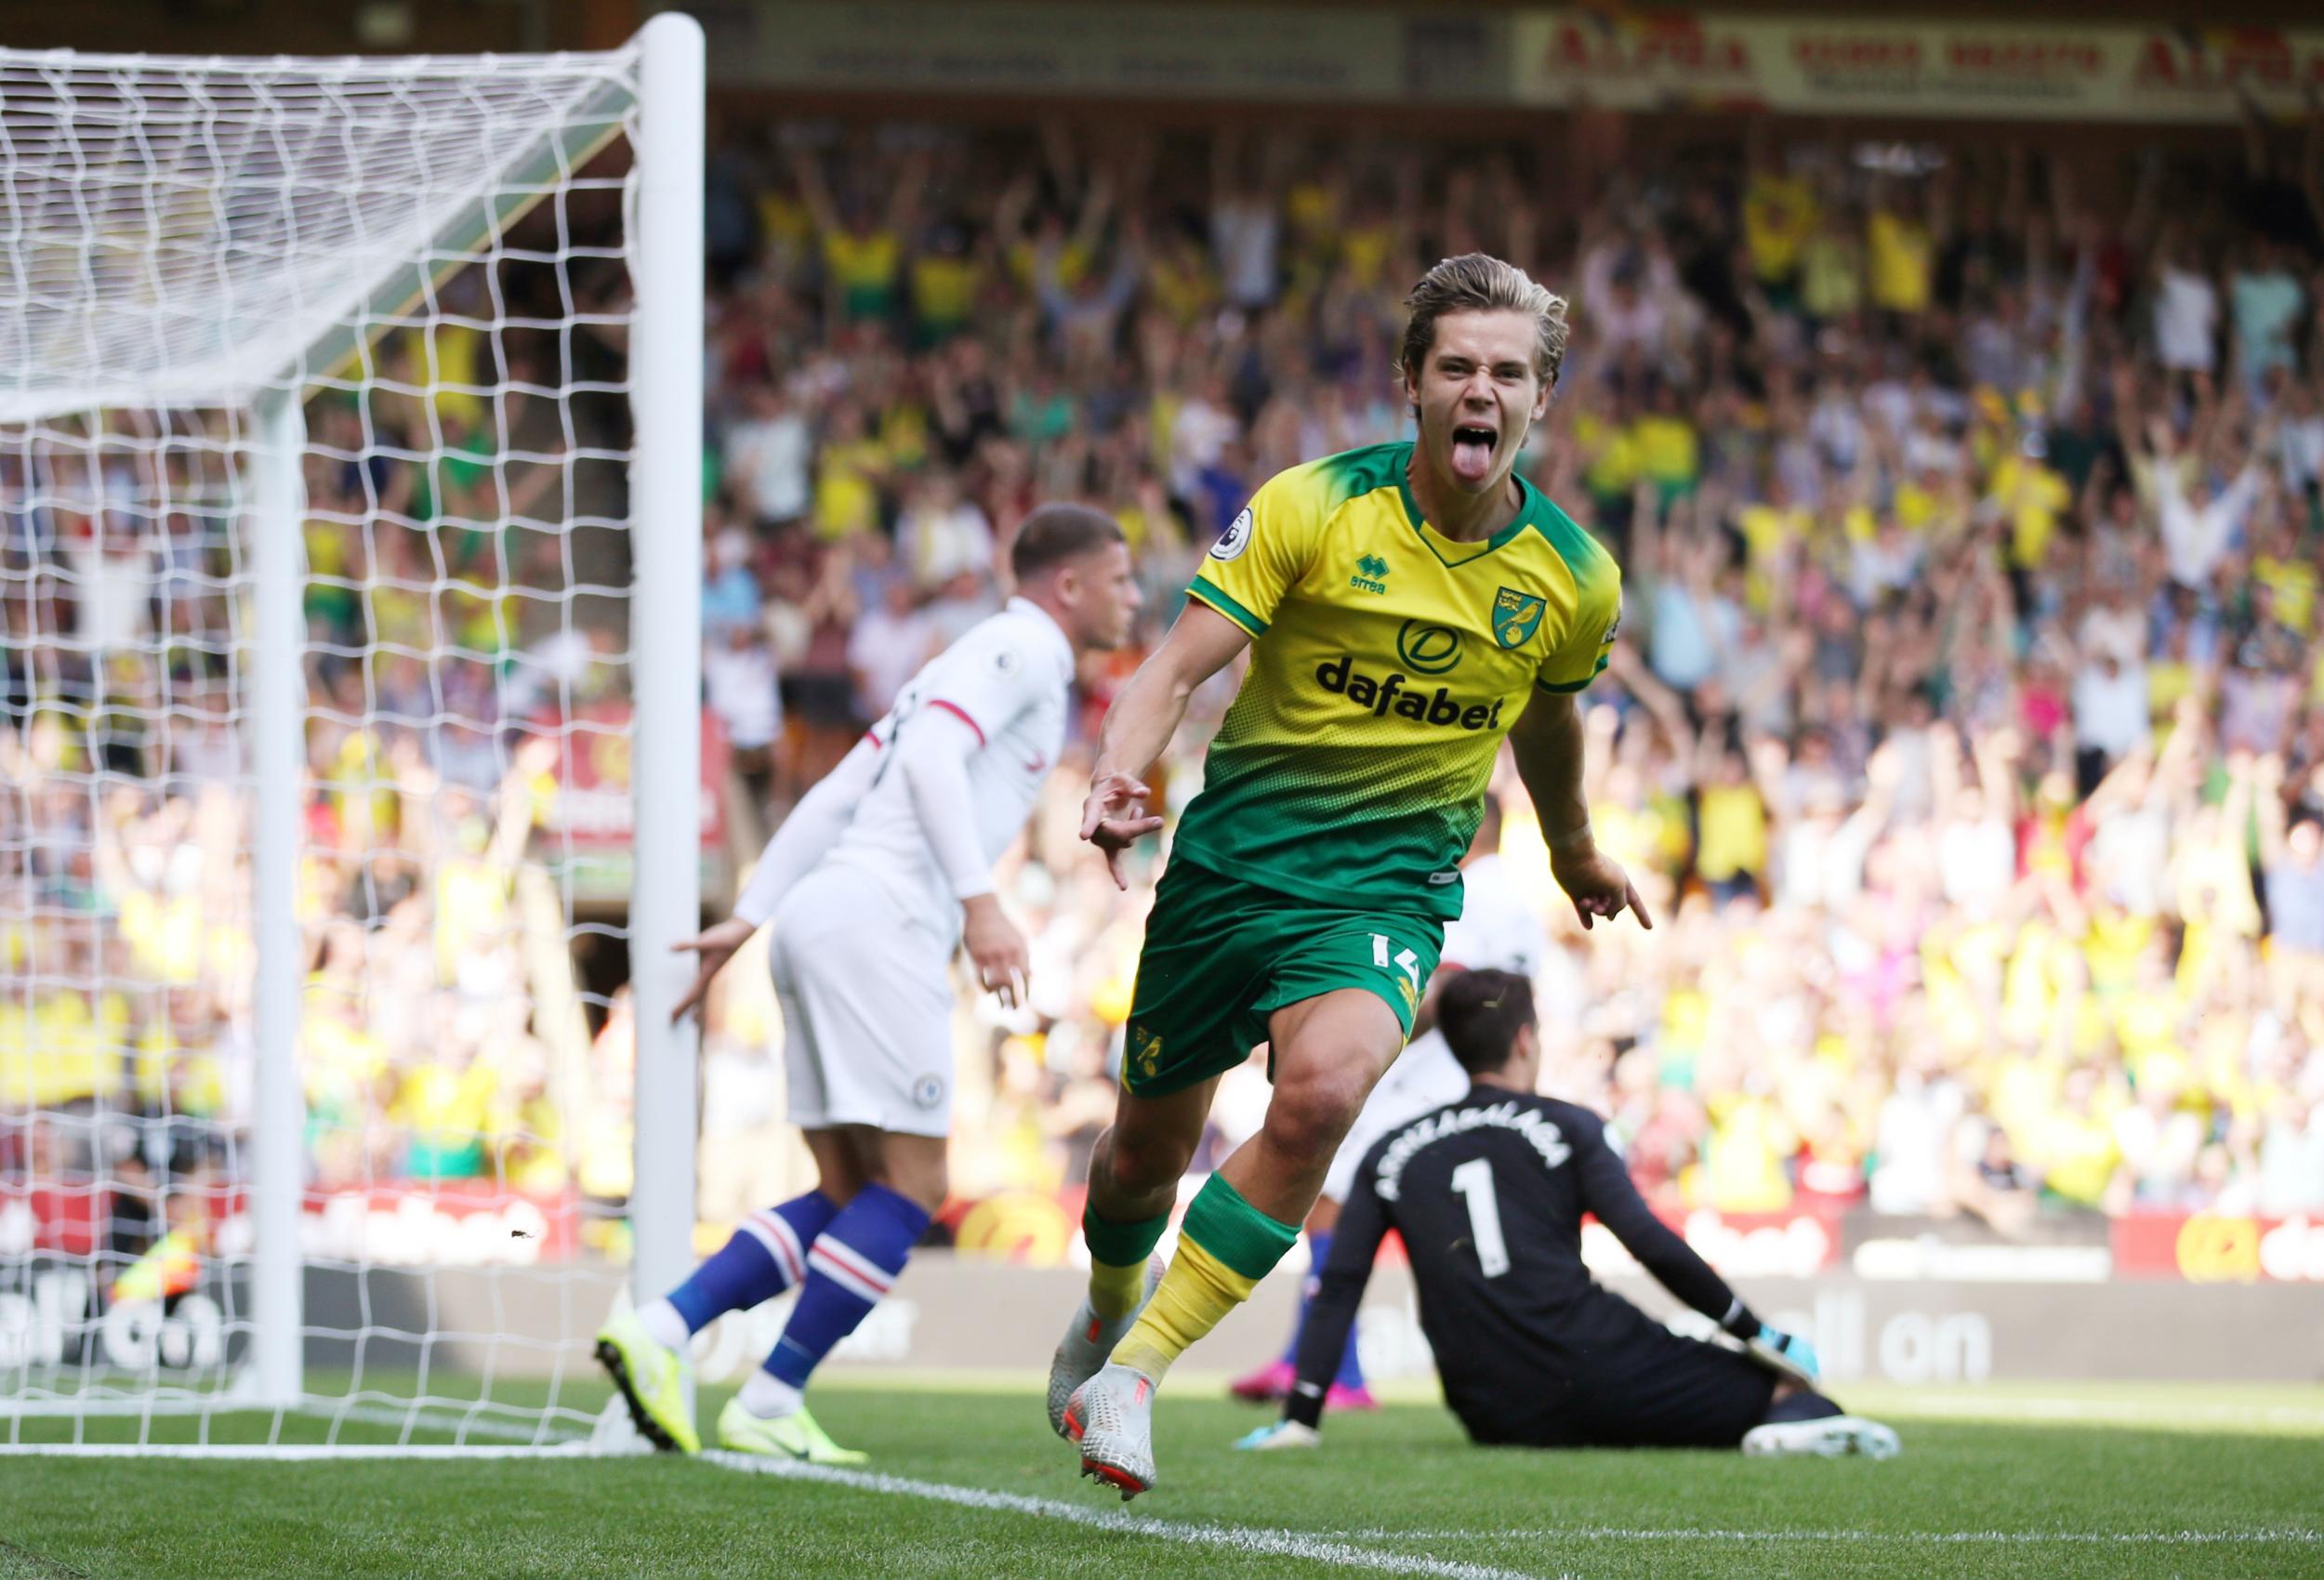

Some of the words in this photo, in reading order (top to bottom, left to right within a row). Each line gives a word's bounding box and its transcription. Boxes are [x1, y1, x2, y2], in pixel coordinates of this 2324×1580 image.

[1315, 656, 1504, 731] dafabet
[1451, 1157, 1511, 1279] 1
[1880, 1309, 1992, 1384] on
